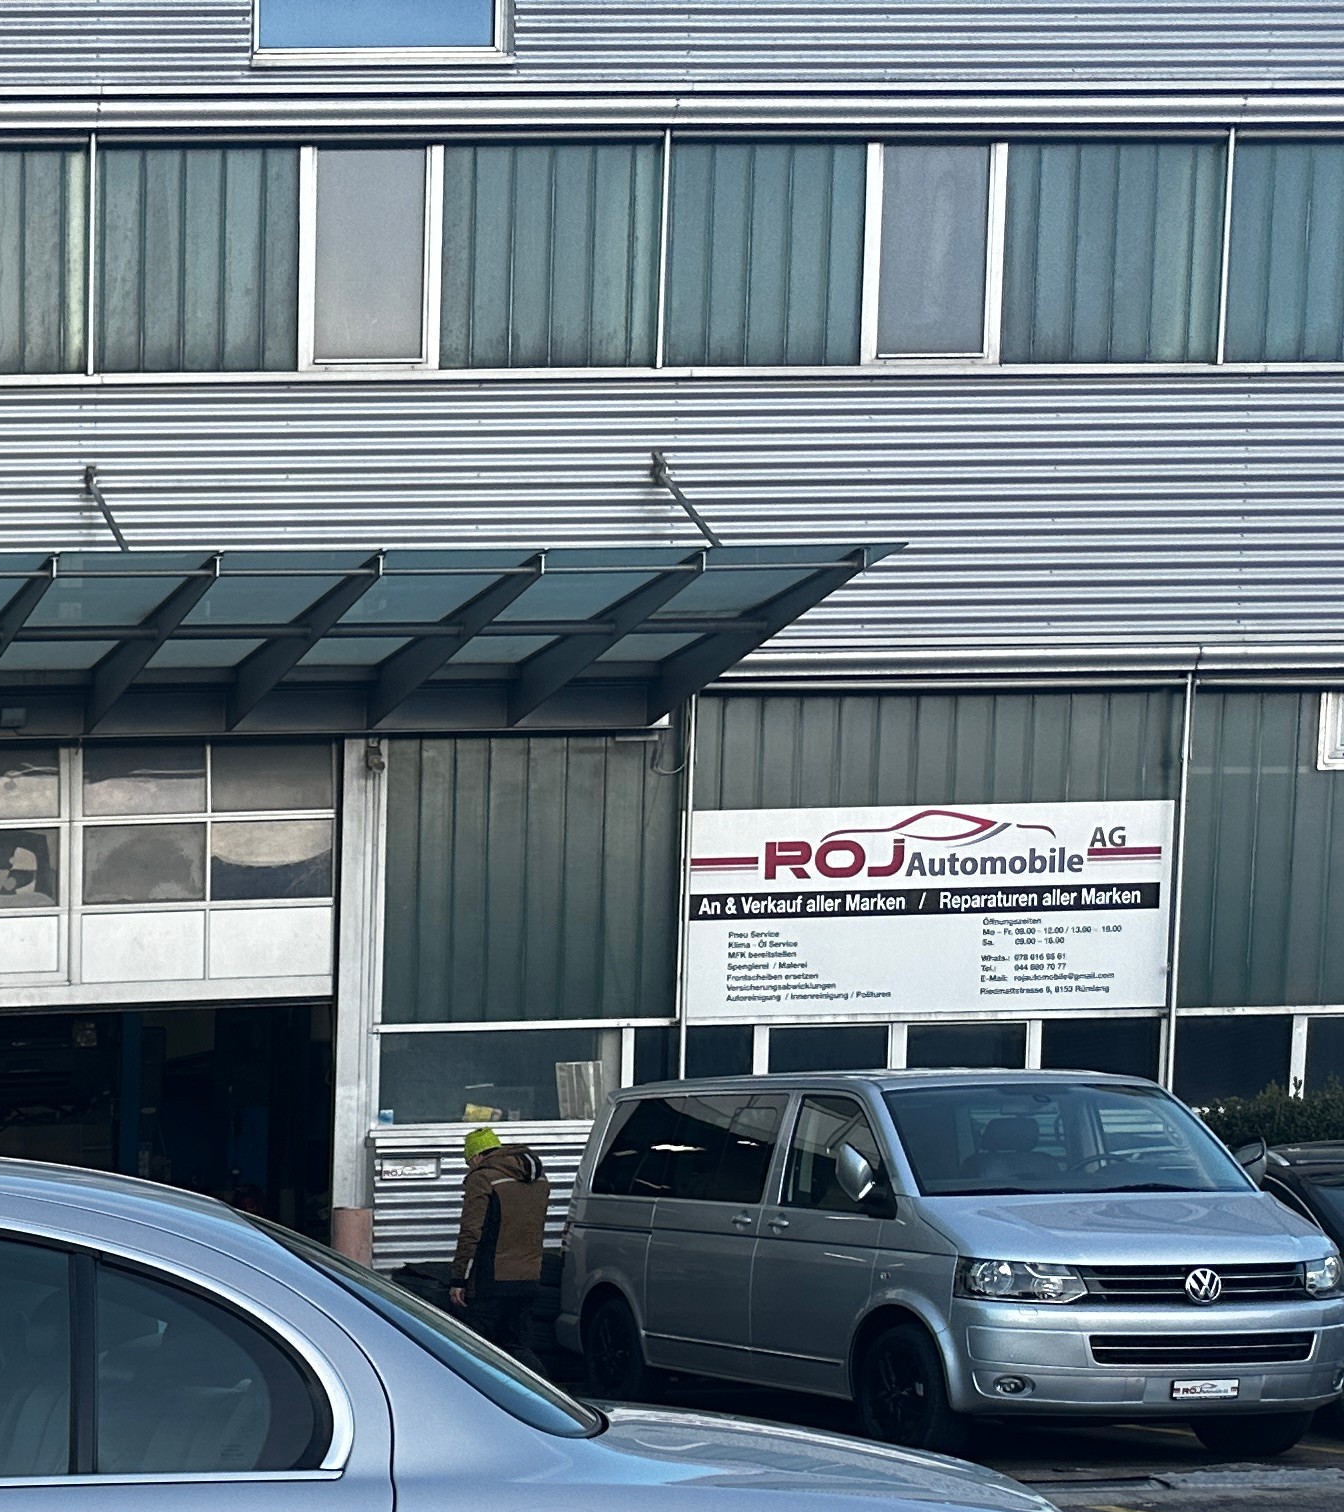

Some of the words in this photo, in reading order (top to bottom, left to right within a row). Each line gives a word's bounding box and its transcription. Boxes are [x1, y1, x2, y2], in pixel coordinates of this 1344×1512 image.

[764, 838, 905, 880] ROJ
[905, 847, 1084, 877] Automobile
[1090, 826, 1127, 848] AG
[698, 898, 720, 916] An
[725, 897, 737, 914] &
[741, 895, 802, 914] Verkauf
[806, 894, 841, 912] aller
[846, 893, 905, 911] Marken
[919, 892, 926, 909] /
[939, 891, 1037, 911] Reparaturen
[1042, 889, 1077, 906] aller
[1081, 887, 1141, 905] Marken
[751, 930, 780, 938] Service
[769, 940, 798, 948] Service
